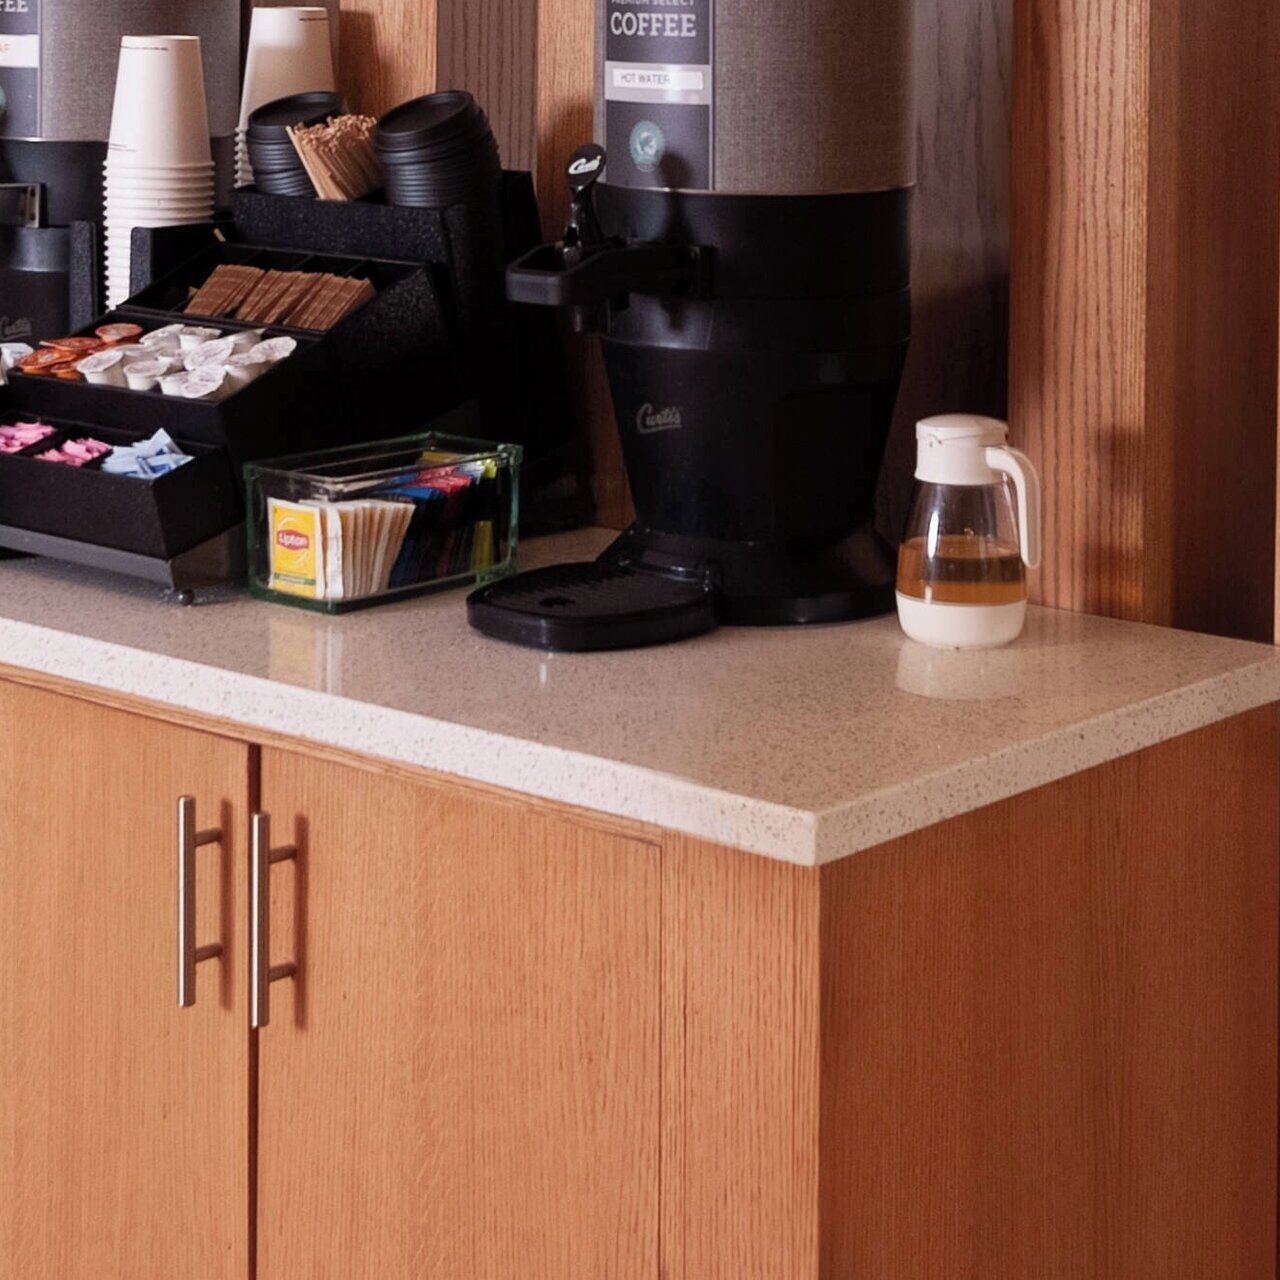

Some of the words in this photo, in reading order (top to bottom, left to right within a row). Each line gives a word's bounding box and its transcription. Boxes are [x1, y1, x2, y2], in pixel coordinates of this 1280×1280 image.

[610, 11, 697, 38] COFFEE
[638, 73, 671, 85] WATER
[277, 530, 309, 548] Lipton
